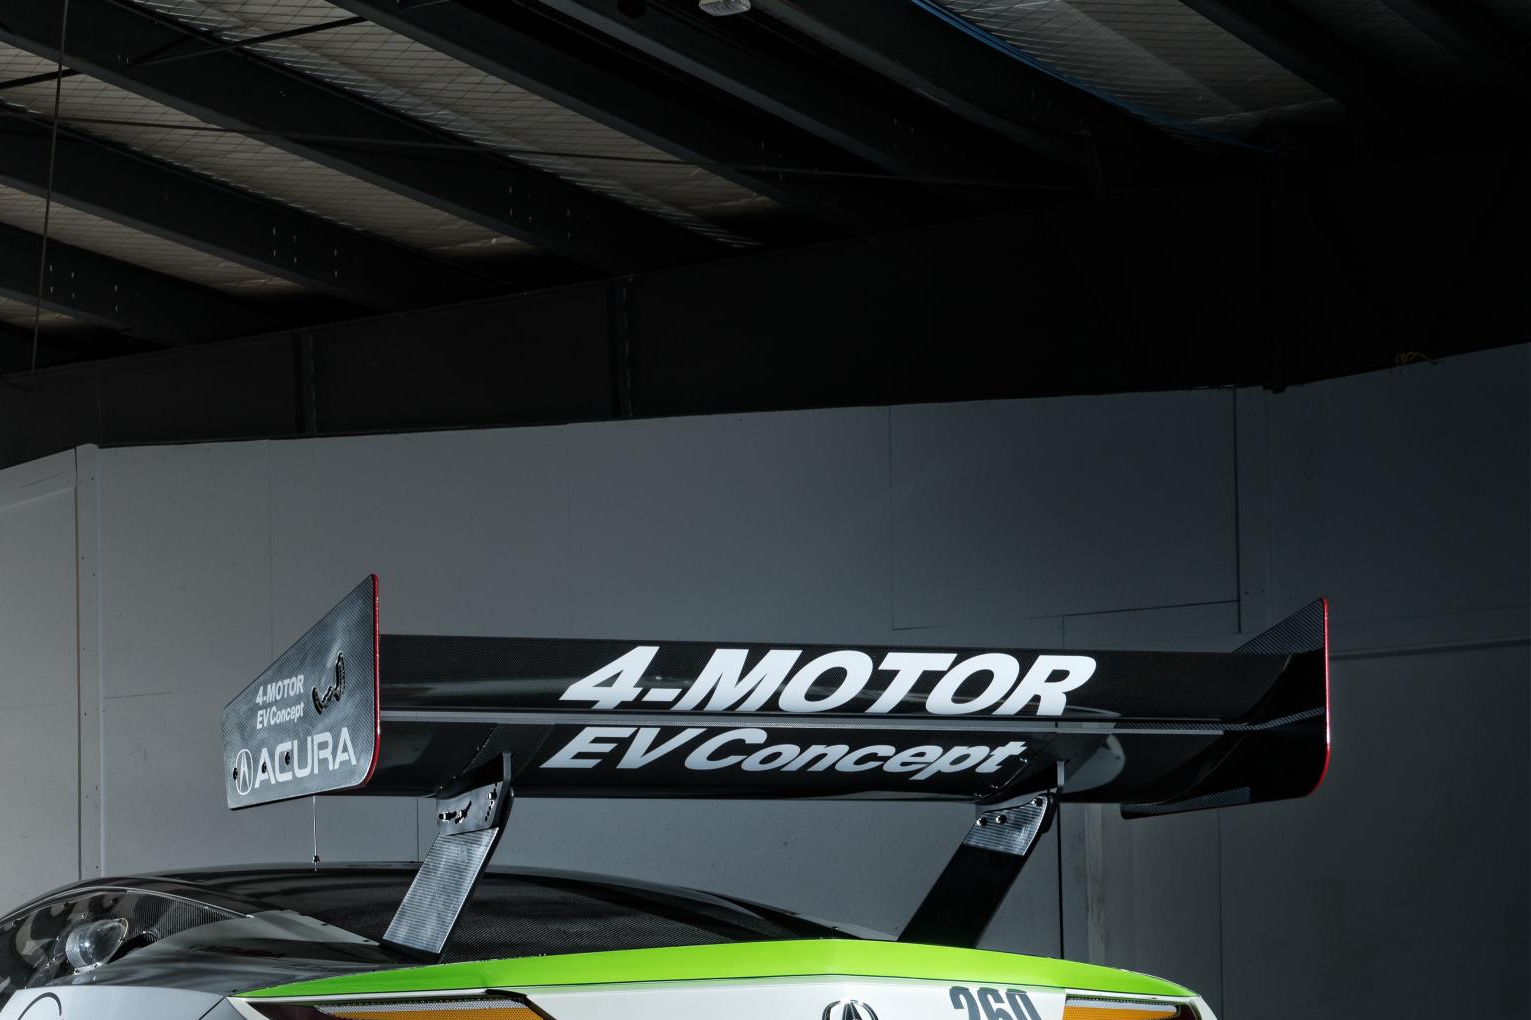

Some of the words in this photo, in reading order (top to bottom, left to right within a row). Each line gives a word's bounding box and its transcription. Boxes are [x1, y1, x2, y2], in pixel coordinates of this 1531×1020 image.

[256, 674, 304, 705] 4-MOTOR
[559, 646, 1097, 716] 4-MOTOR
[257, 707, 271, 729] EV
[270, 702, 304, 725] Concept
[254, 727, 357, 788] ACURA
[540, 727, 707, 769] EV
[684, 727, 1027, 780] Concept
